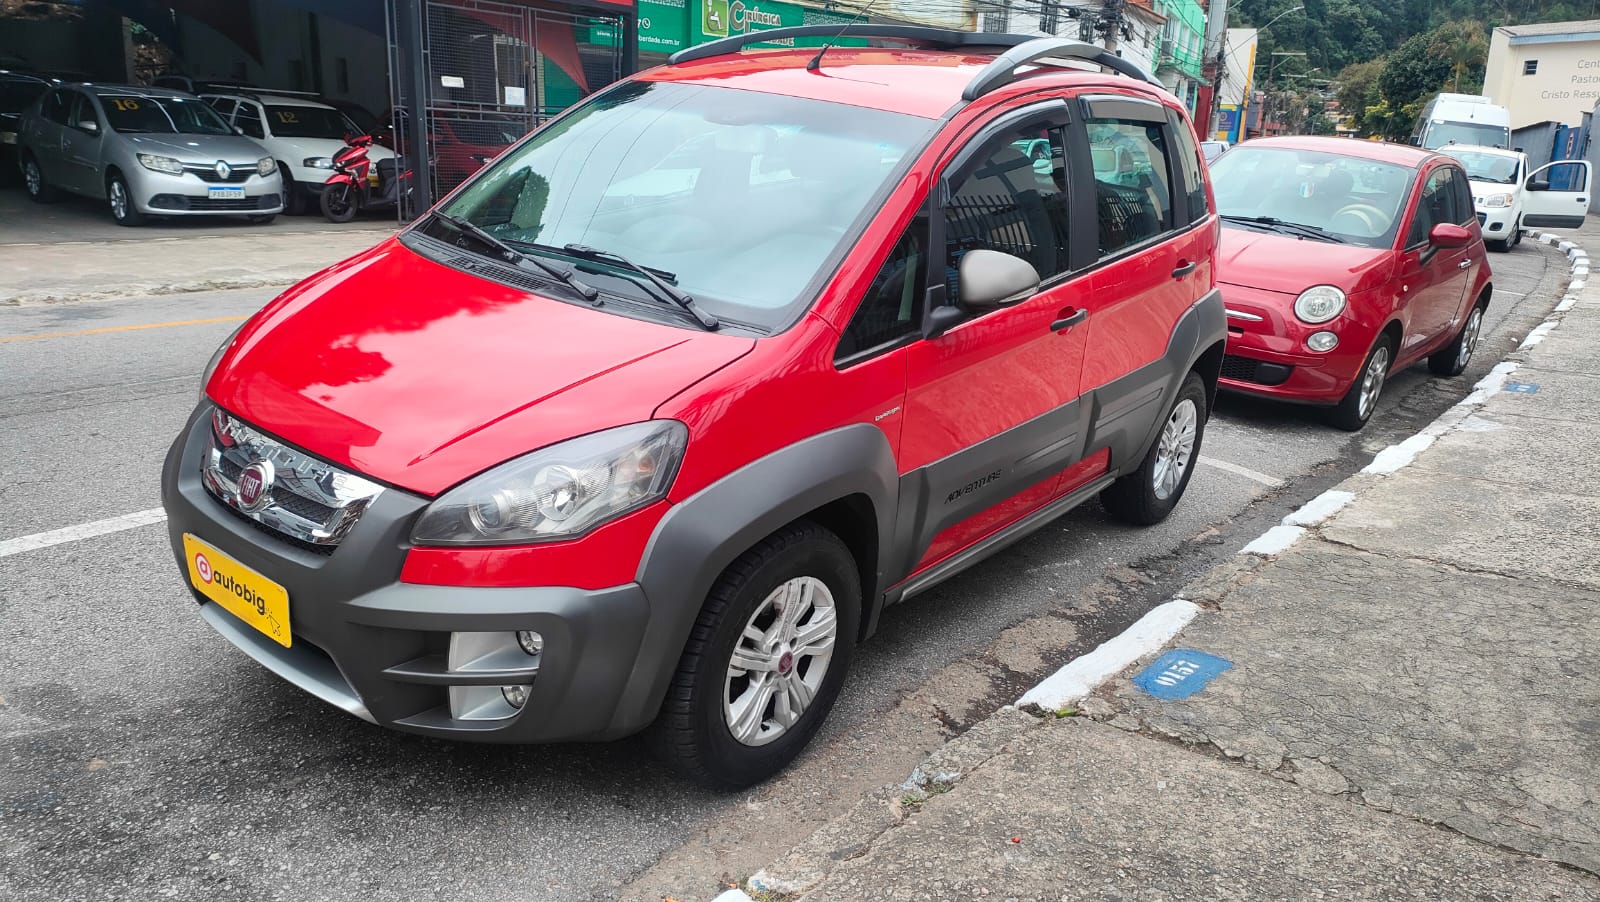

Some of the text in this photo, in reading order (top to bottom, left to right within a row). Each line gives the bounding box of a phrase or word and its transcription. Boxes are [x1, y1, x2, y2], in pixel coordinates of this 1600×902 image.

[1541, 90, 1569, 99] Cristo
[112, 98, 140, 111] 16
[275, 110, 299, 124] 12
[241, 474, 261, 499] FIAT
[944, 468, 1002, 504] ADVENTURE
